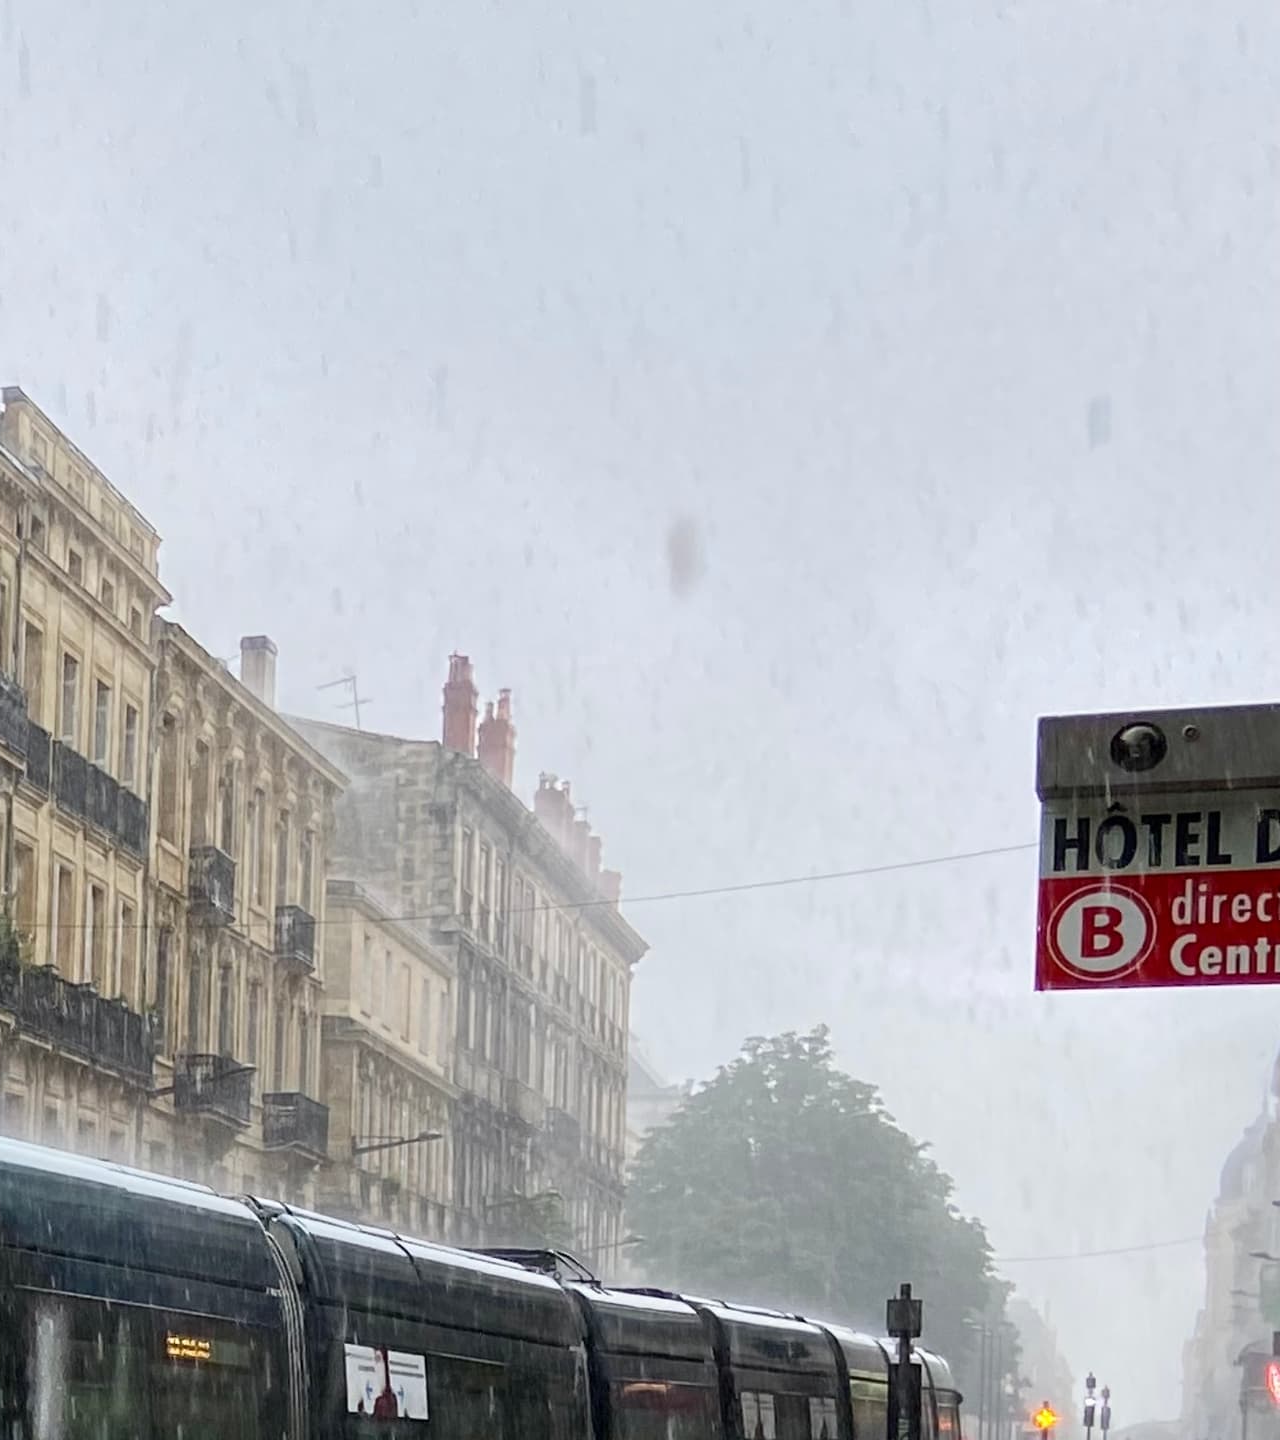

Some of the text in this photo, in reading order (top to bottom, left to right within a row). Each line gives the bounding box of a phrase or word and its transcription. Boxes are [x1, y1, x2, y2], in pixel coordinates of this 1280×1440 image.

[1053, 801, 1232, 872] HÔTEL
[1171, 878, 1280, 925] direc
[1080, 905, 1125, 959] B
